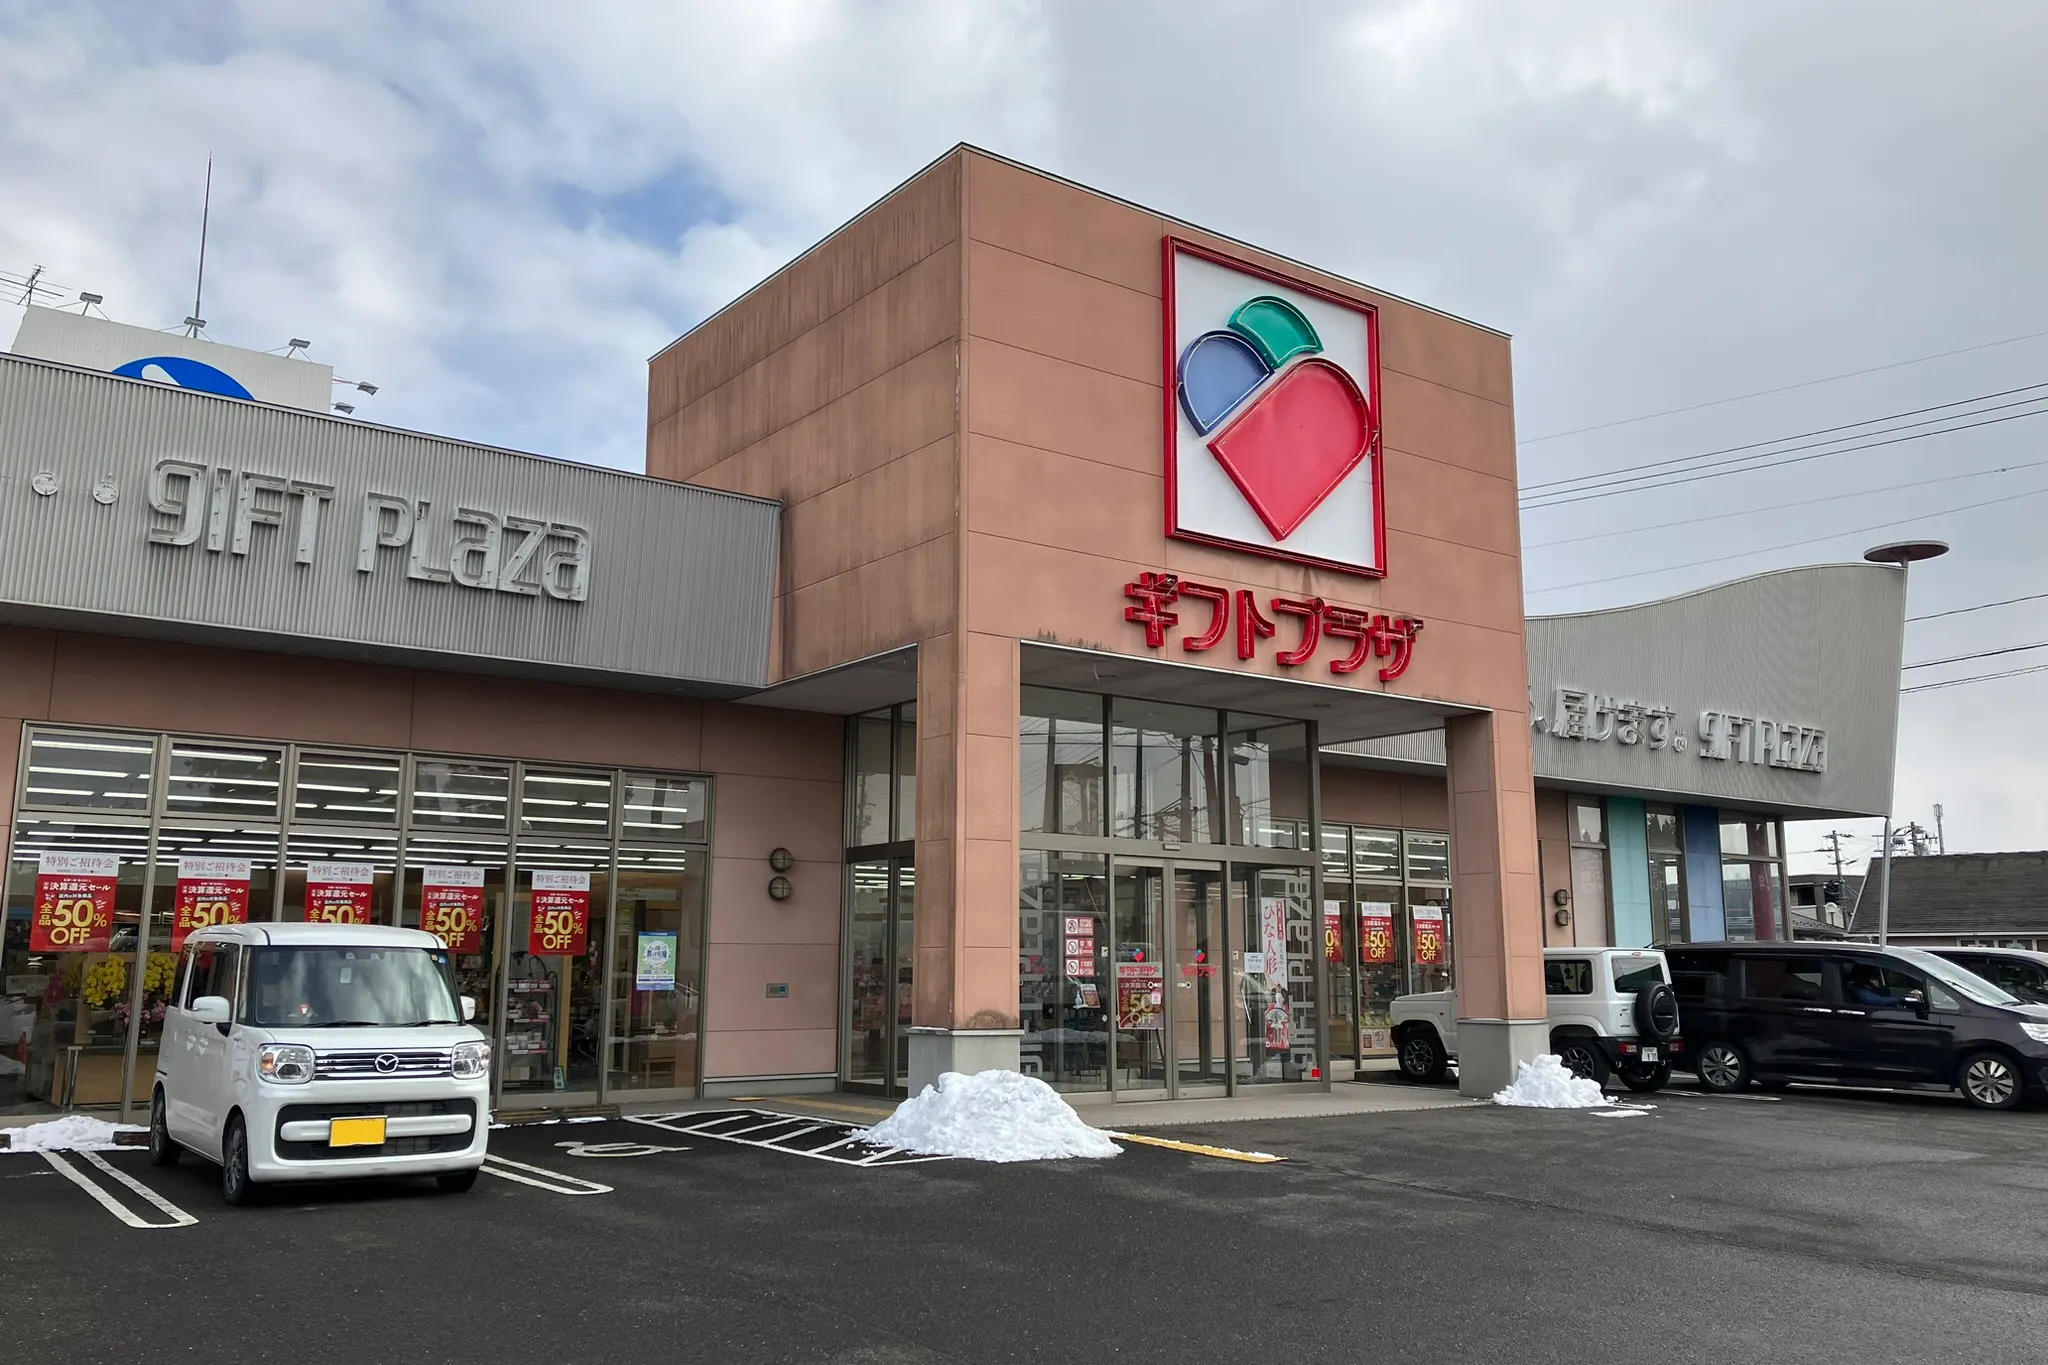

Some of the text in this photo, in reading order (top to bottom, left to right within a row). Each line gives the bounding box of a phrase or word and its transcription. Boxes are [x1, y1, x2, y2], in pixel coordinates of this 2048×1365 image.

[1124, 572, 1424, 683] ギフトプラザ
[45, 856, 114, 869] 特別ご招待会
[183, 861, 246, 872] 特別ご招待会
[38, 902, 53, 926] 全品
[52, 900, 107, 928] 50%
[179, 905, 192, 928] 全品
[50, 927, 90, 944] OFF
[542, 934, 572, 950] OFF
[1263, 904, 1278, 975] ひな人形
[1370, 948, 1386, 958] OFF
[1422, 950, 1436, 960] OFF
